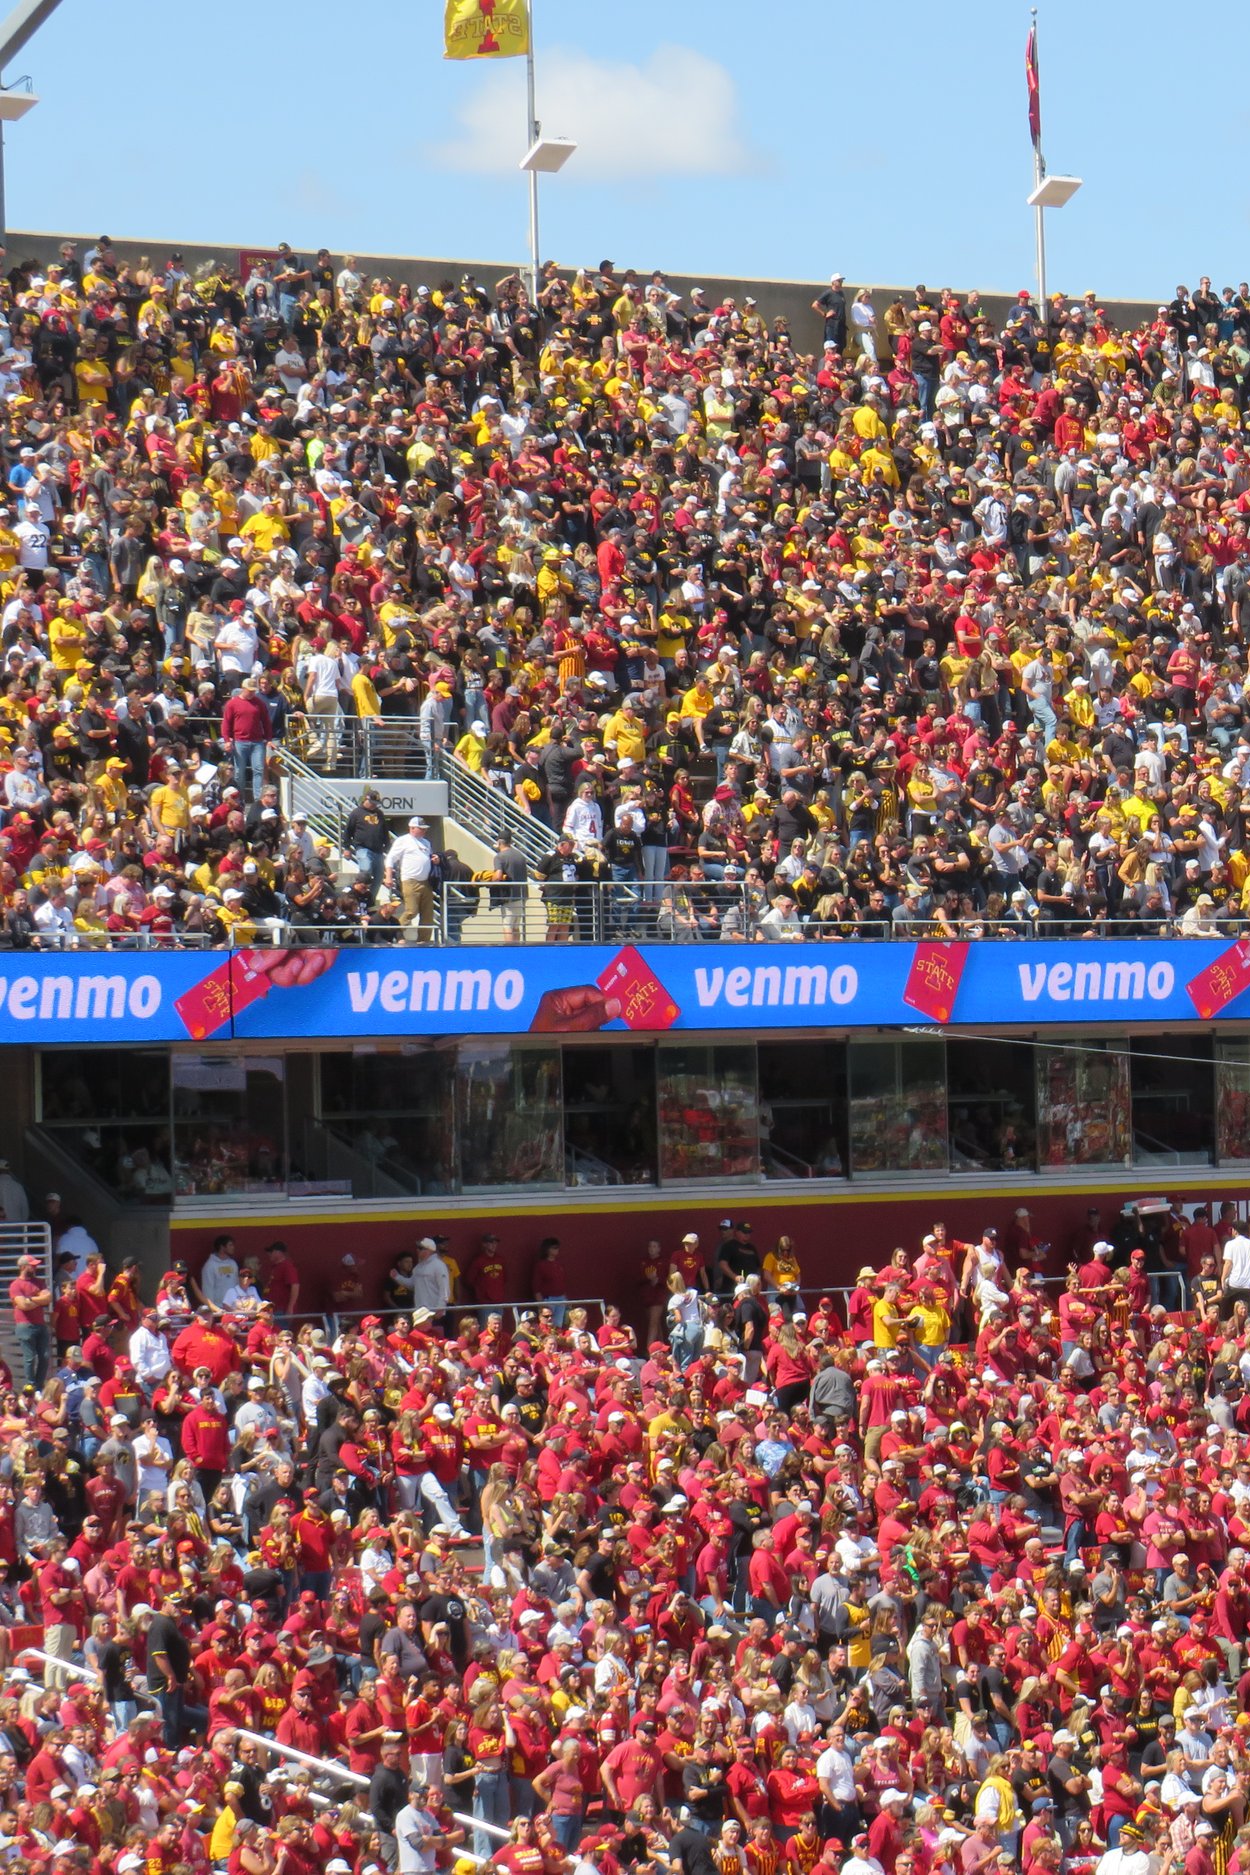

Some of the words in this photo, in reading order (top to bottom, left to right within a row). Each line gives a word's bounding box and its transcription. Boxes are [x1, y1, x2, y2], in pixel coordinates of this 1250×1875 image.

[30, 534, 47, 548] 22
[347, 969, 525, 1013] venmo
[694, 964, 858, 1007] venmo
[916, 959, 955, 990] STATE
[1018, 961, 1175, 1001] venmo
[1210, 965, 1232, 999] STATE
[0, 975, 161, 1020] enmo
[202, 980, 231, 1018] STATE
[625, 981, 658, 1021] STATE
